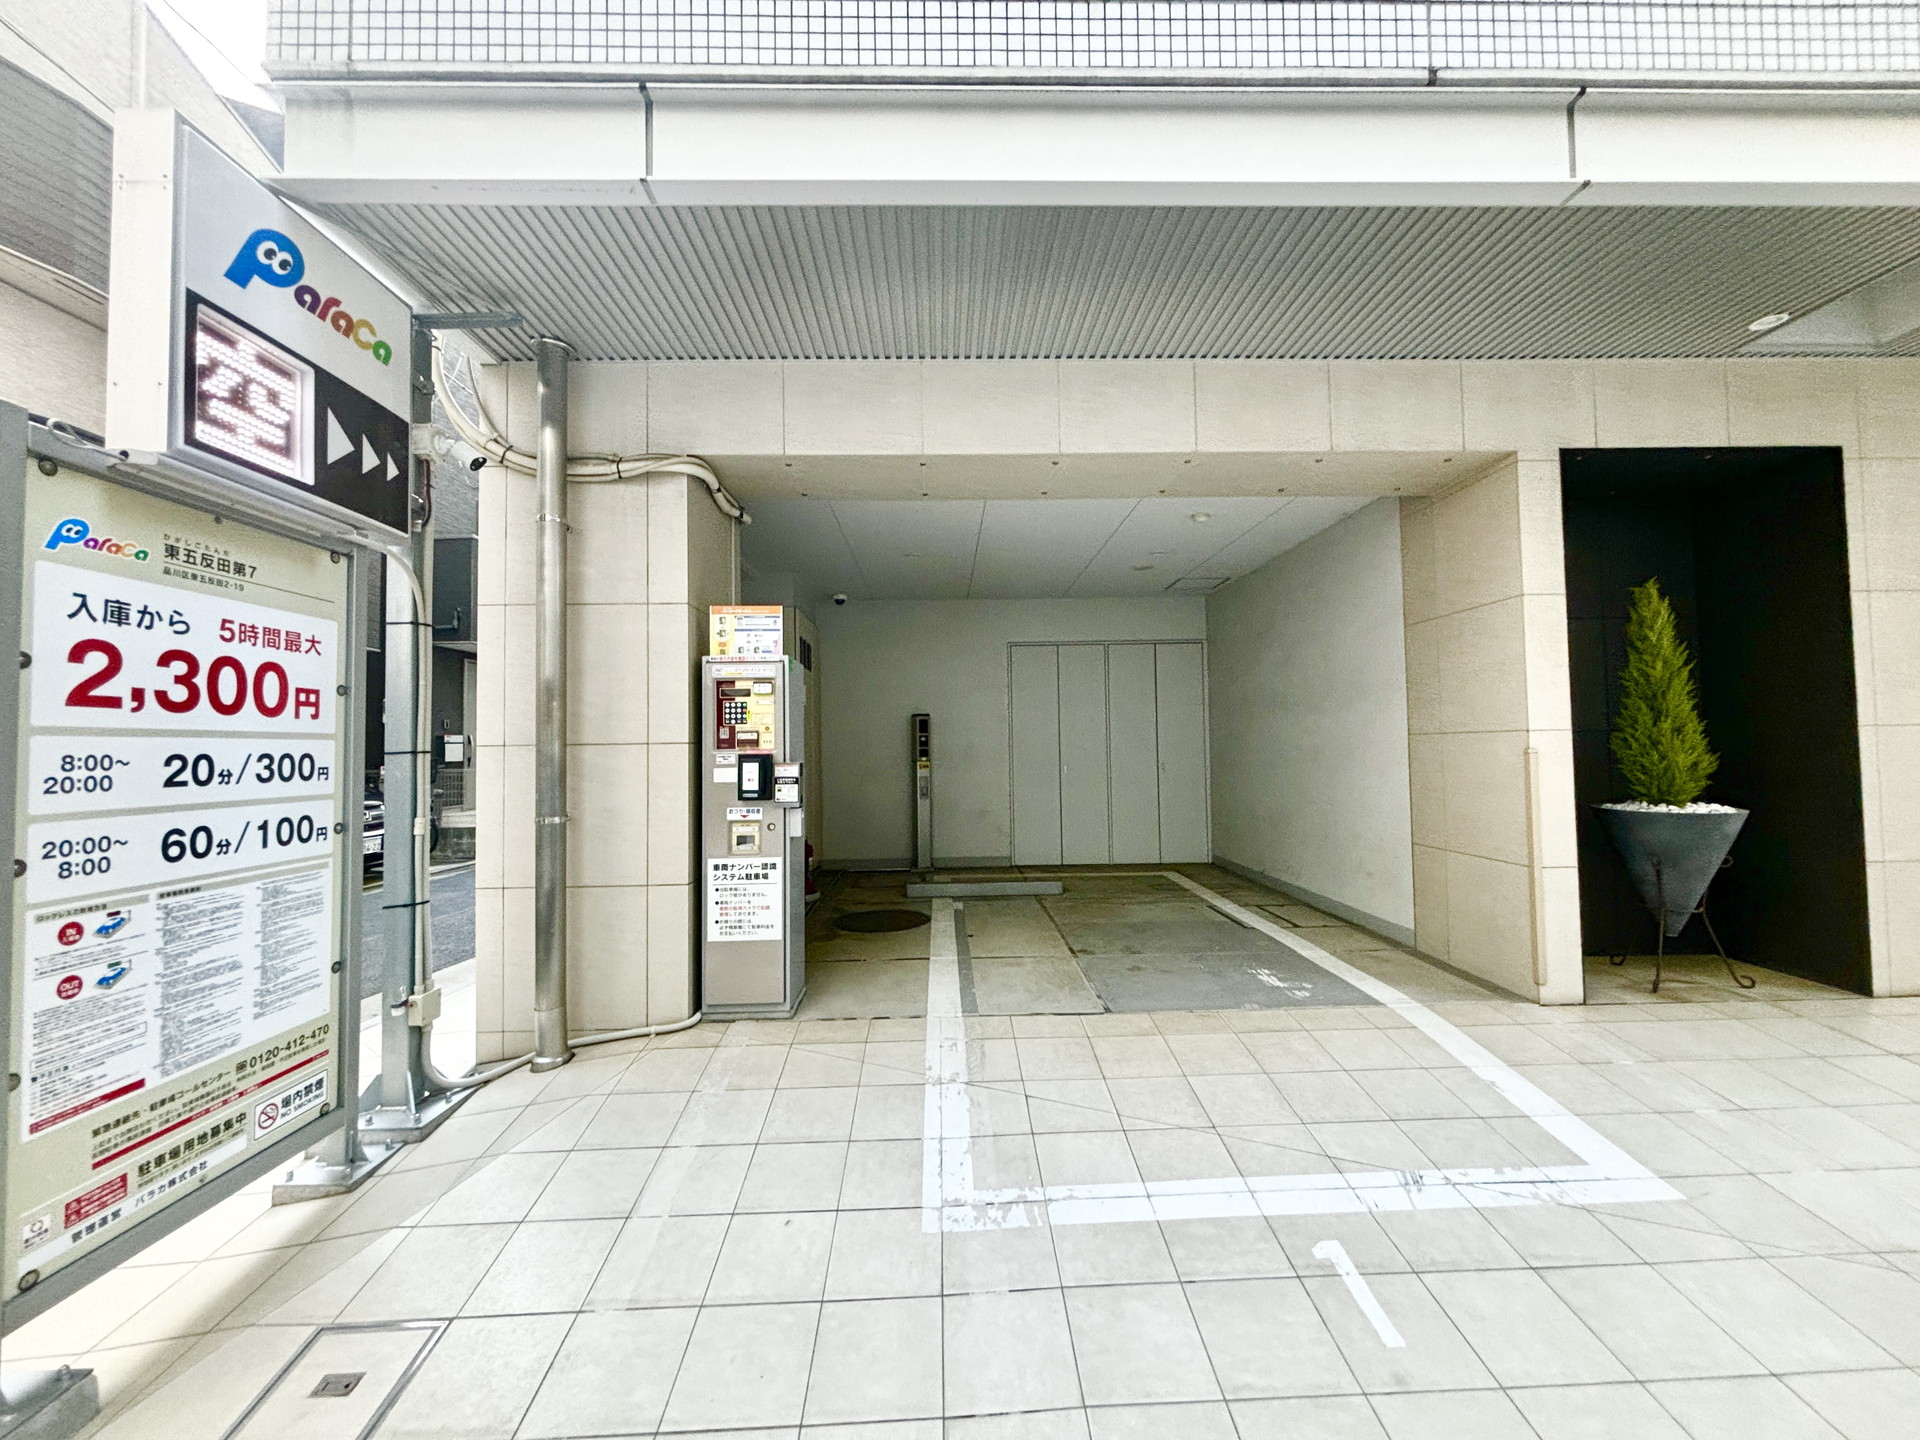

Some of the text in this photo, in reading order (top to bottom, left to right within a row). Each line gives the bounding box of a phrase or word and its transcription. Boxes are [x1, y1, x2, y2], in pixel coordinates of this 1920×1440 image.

[163, 543, 258, 579] 東五反田第7
[162, 566, 245, 592] 品川区東五反田2-19
[66, 592, 322, 656] 入庫から 5時間最大
[65, 638, 321, 720] 2,300円
[43, 775, 113, 795] 20:00
[57, 856, 111, 879] 8:00
[713, 862, 777, 872] 車両ナンバー認識
[713, 872, 769, 882] システム駐車場
[60, 980, 80, 991] OUT
[249, 1023, 330, 1069] 0120-412-470
[280, 1091, 325, 1119] NO SMOKING
[281, 1076, 325, 1109] 場内禁煙
[70, 1207, 122, 1244] 管理運営
[135, 1160, 209, 1208] パラカ株式会社
[1311, 1239, 1406, 1348] 1
